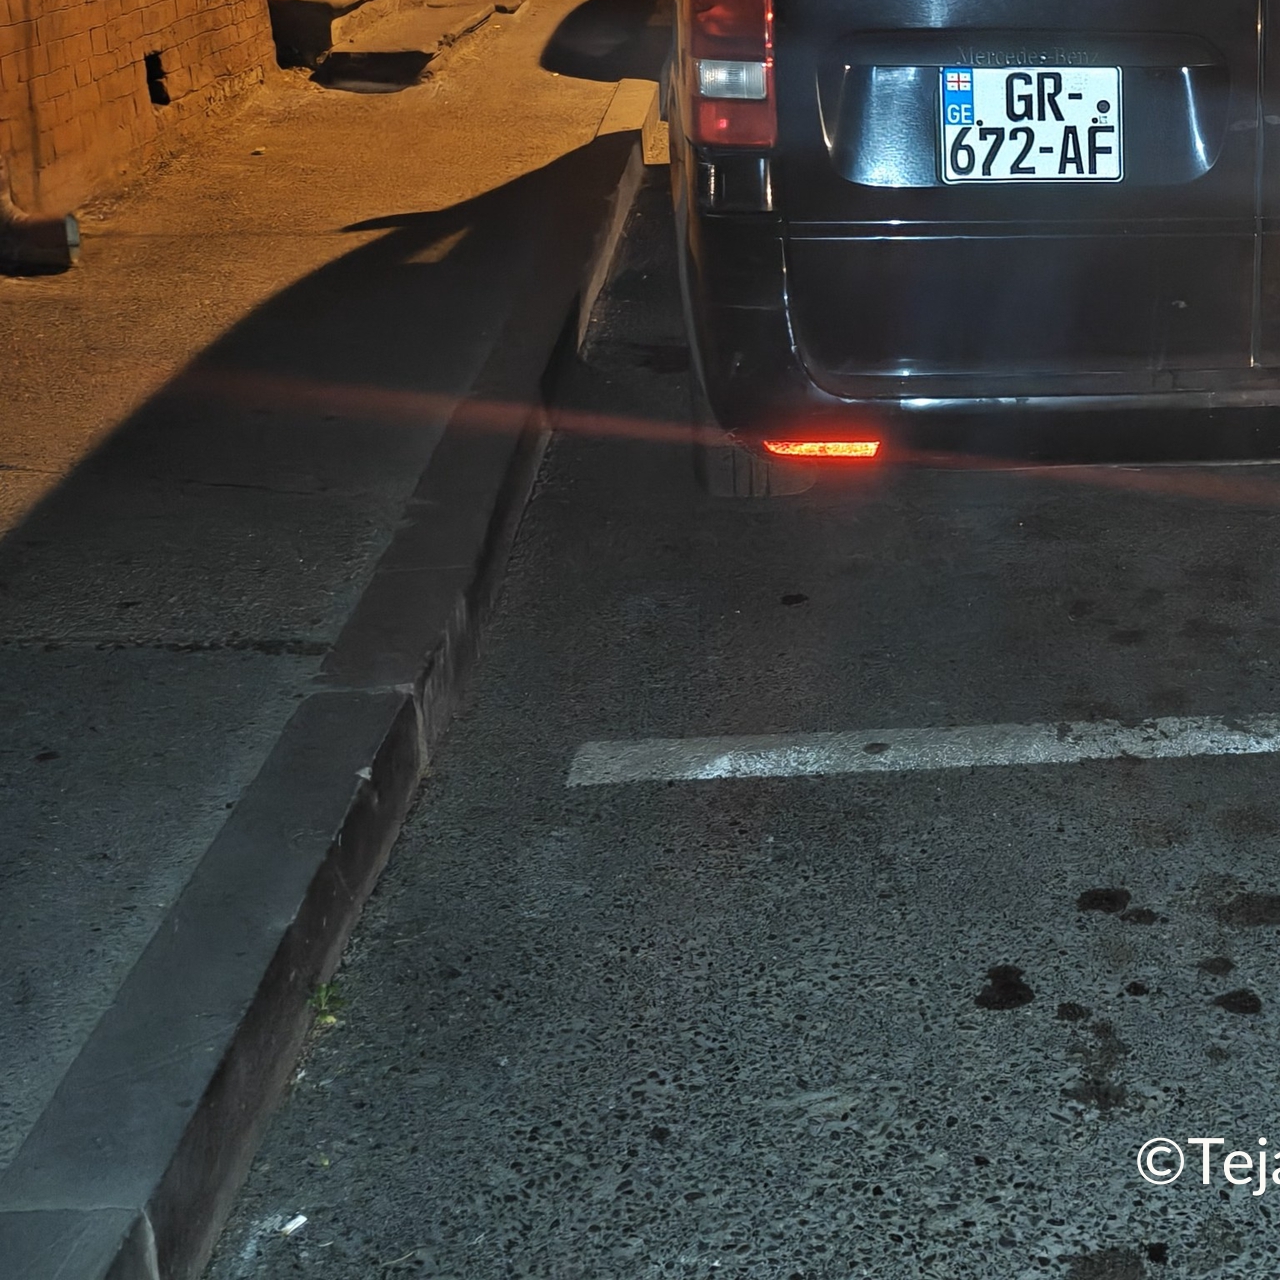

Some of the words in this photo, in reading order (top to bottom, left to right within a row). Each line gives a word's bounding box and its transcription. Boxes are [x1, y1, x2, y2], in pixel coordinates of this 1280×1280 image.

[956, 46, 1100, 65] Mercedes-Benz
[946, 104, 972, 124] GE
[950, 124, 1115, 177] 672-AF
